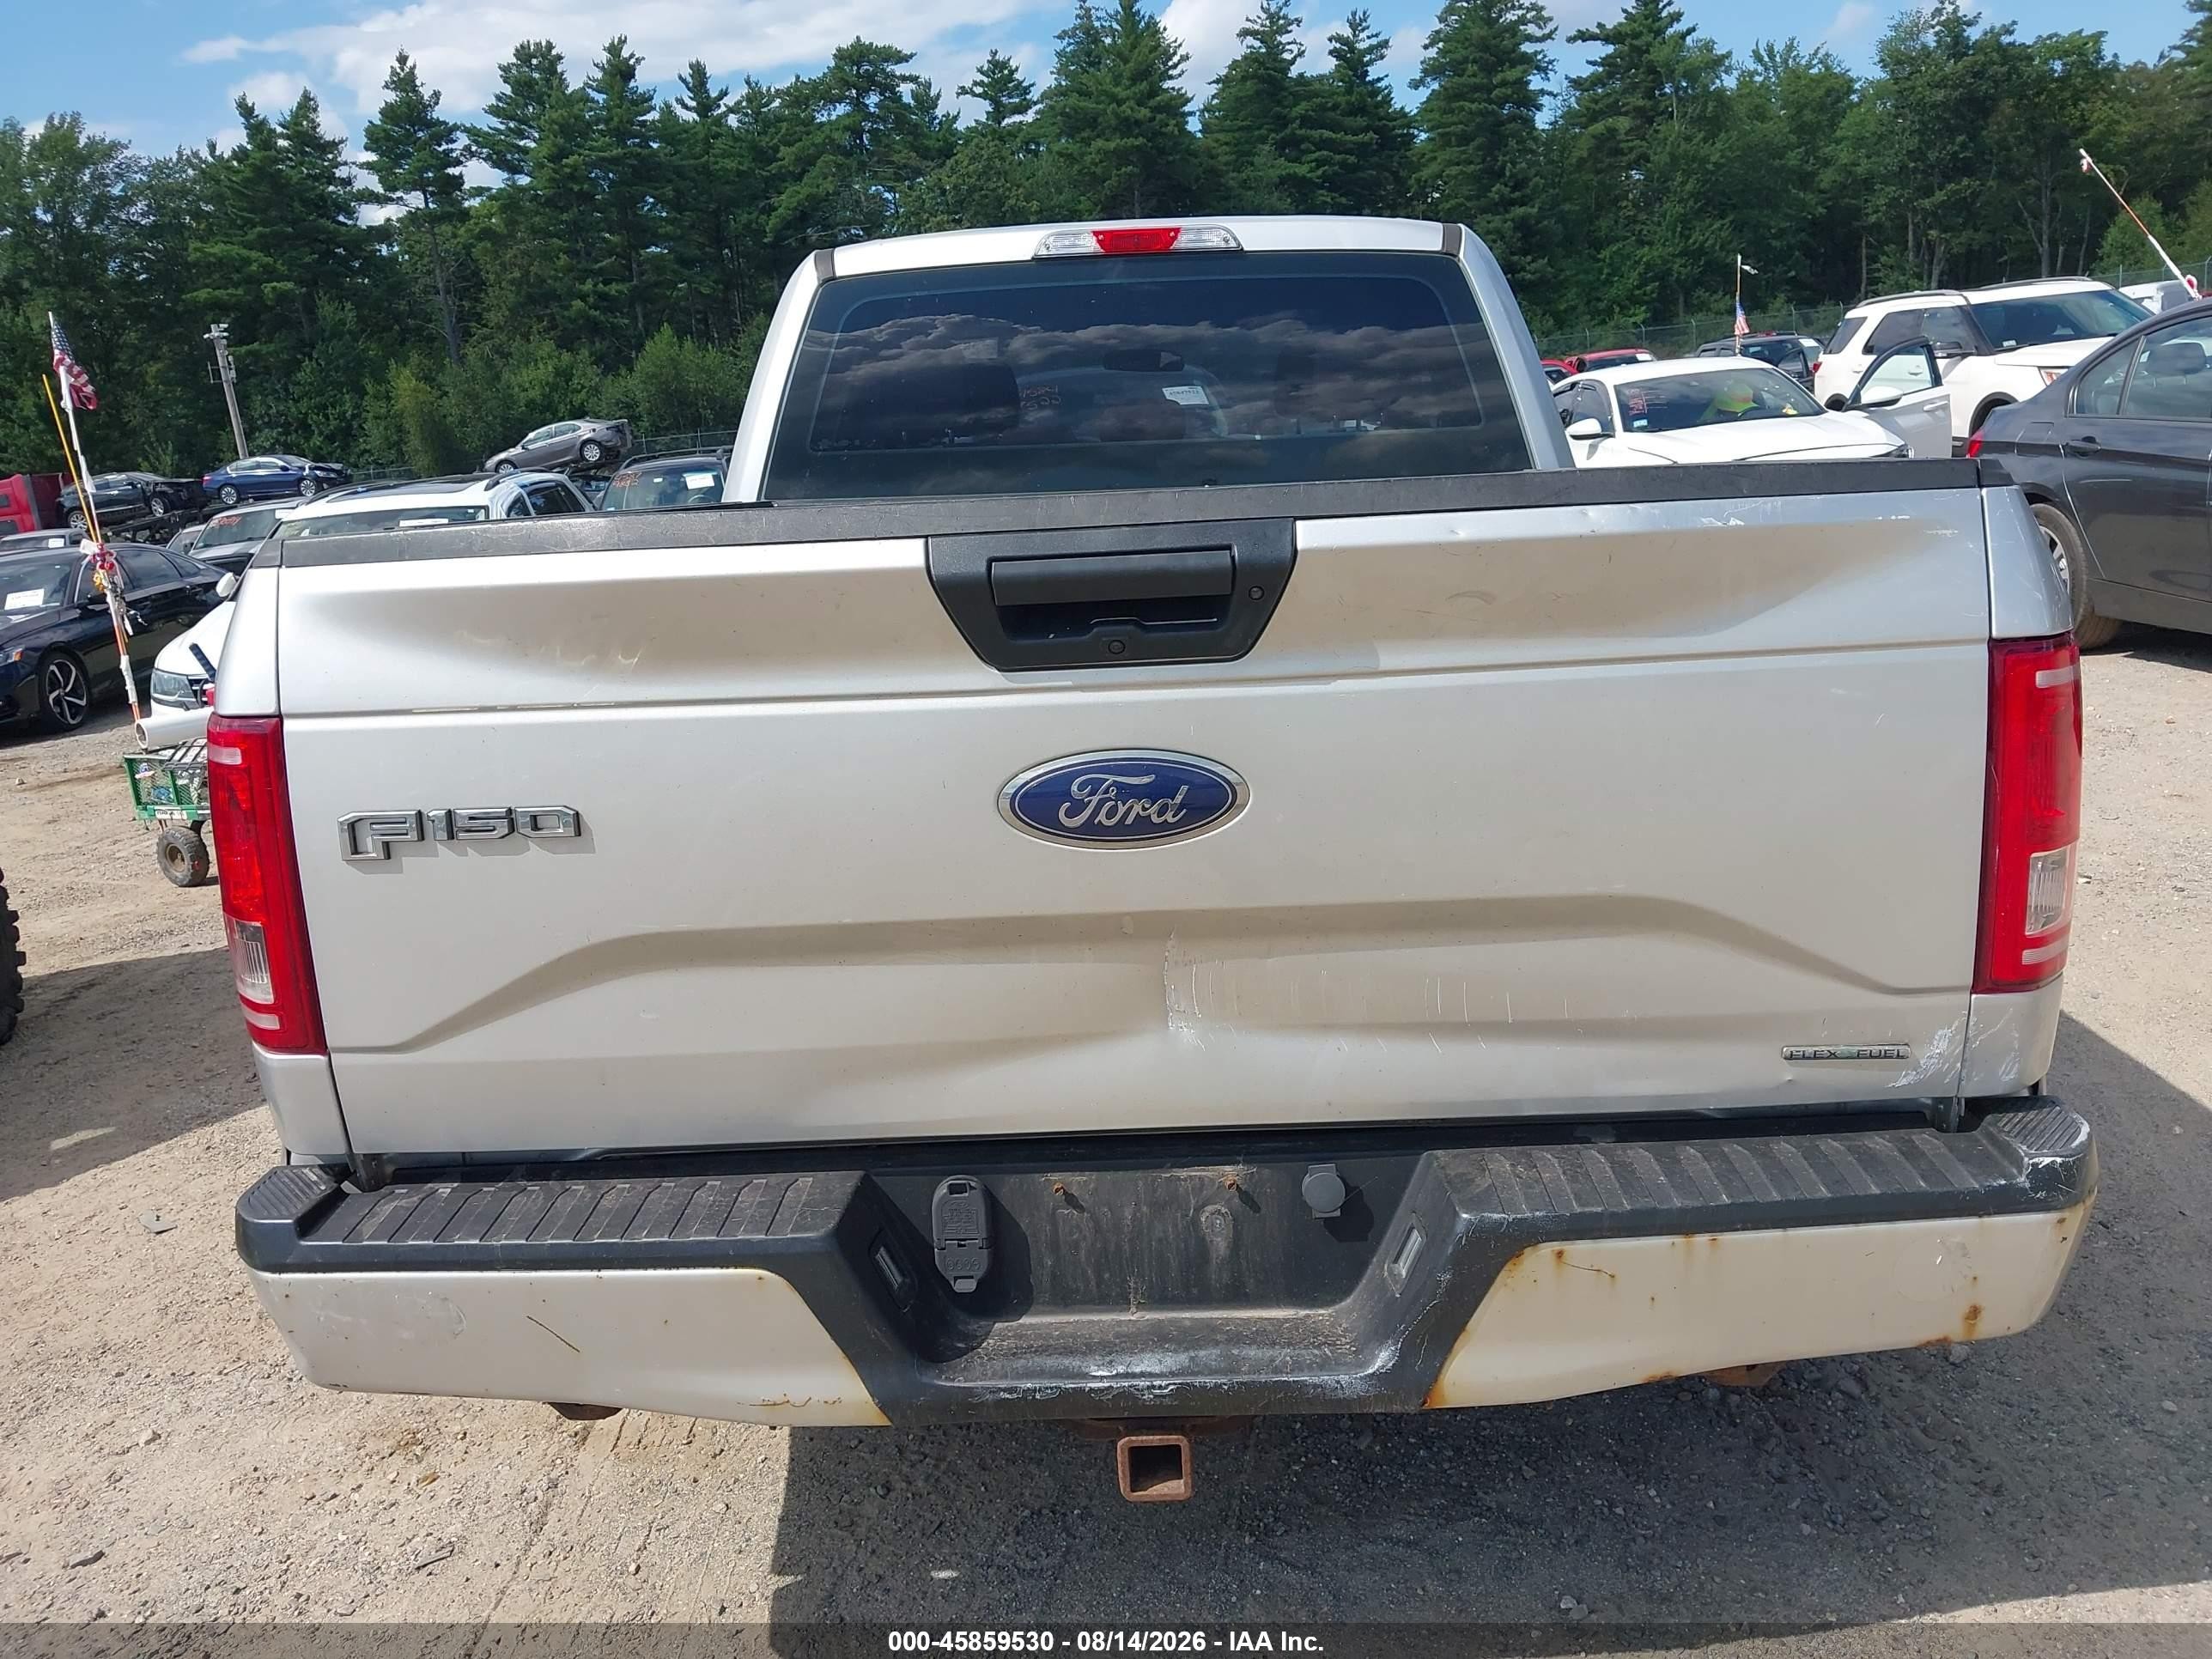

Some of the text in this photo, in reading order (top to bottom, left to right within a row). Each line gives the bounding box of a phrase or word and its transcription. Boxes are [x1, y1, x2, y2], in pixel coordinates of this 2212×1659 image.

[1058, 773, 1189, 828] Ford
[1790, 1048, 1907, 1059] FLEX FUEL
